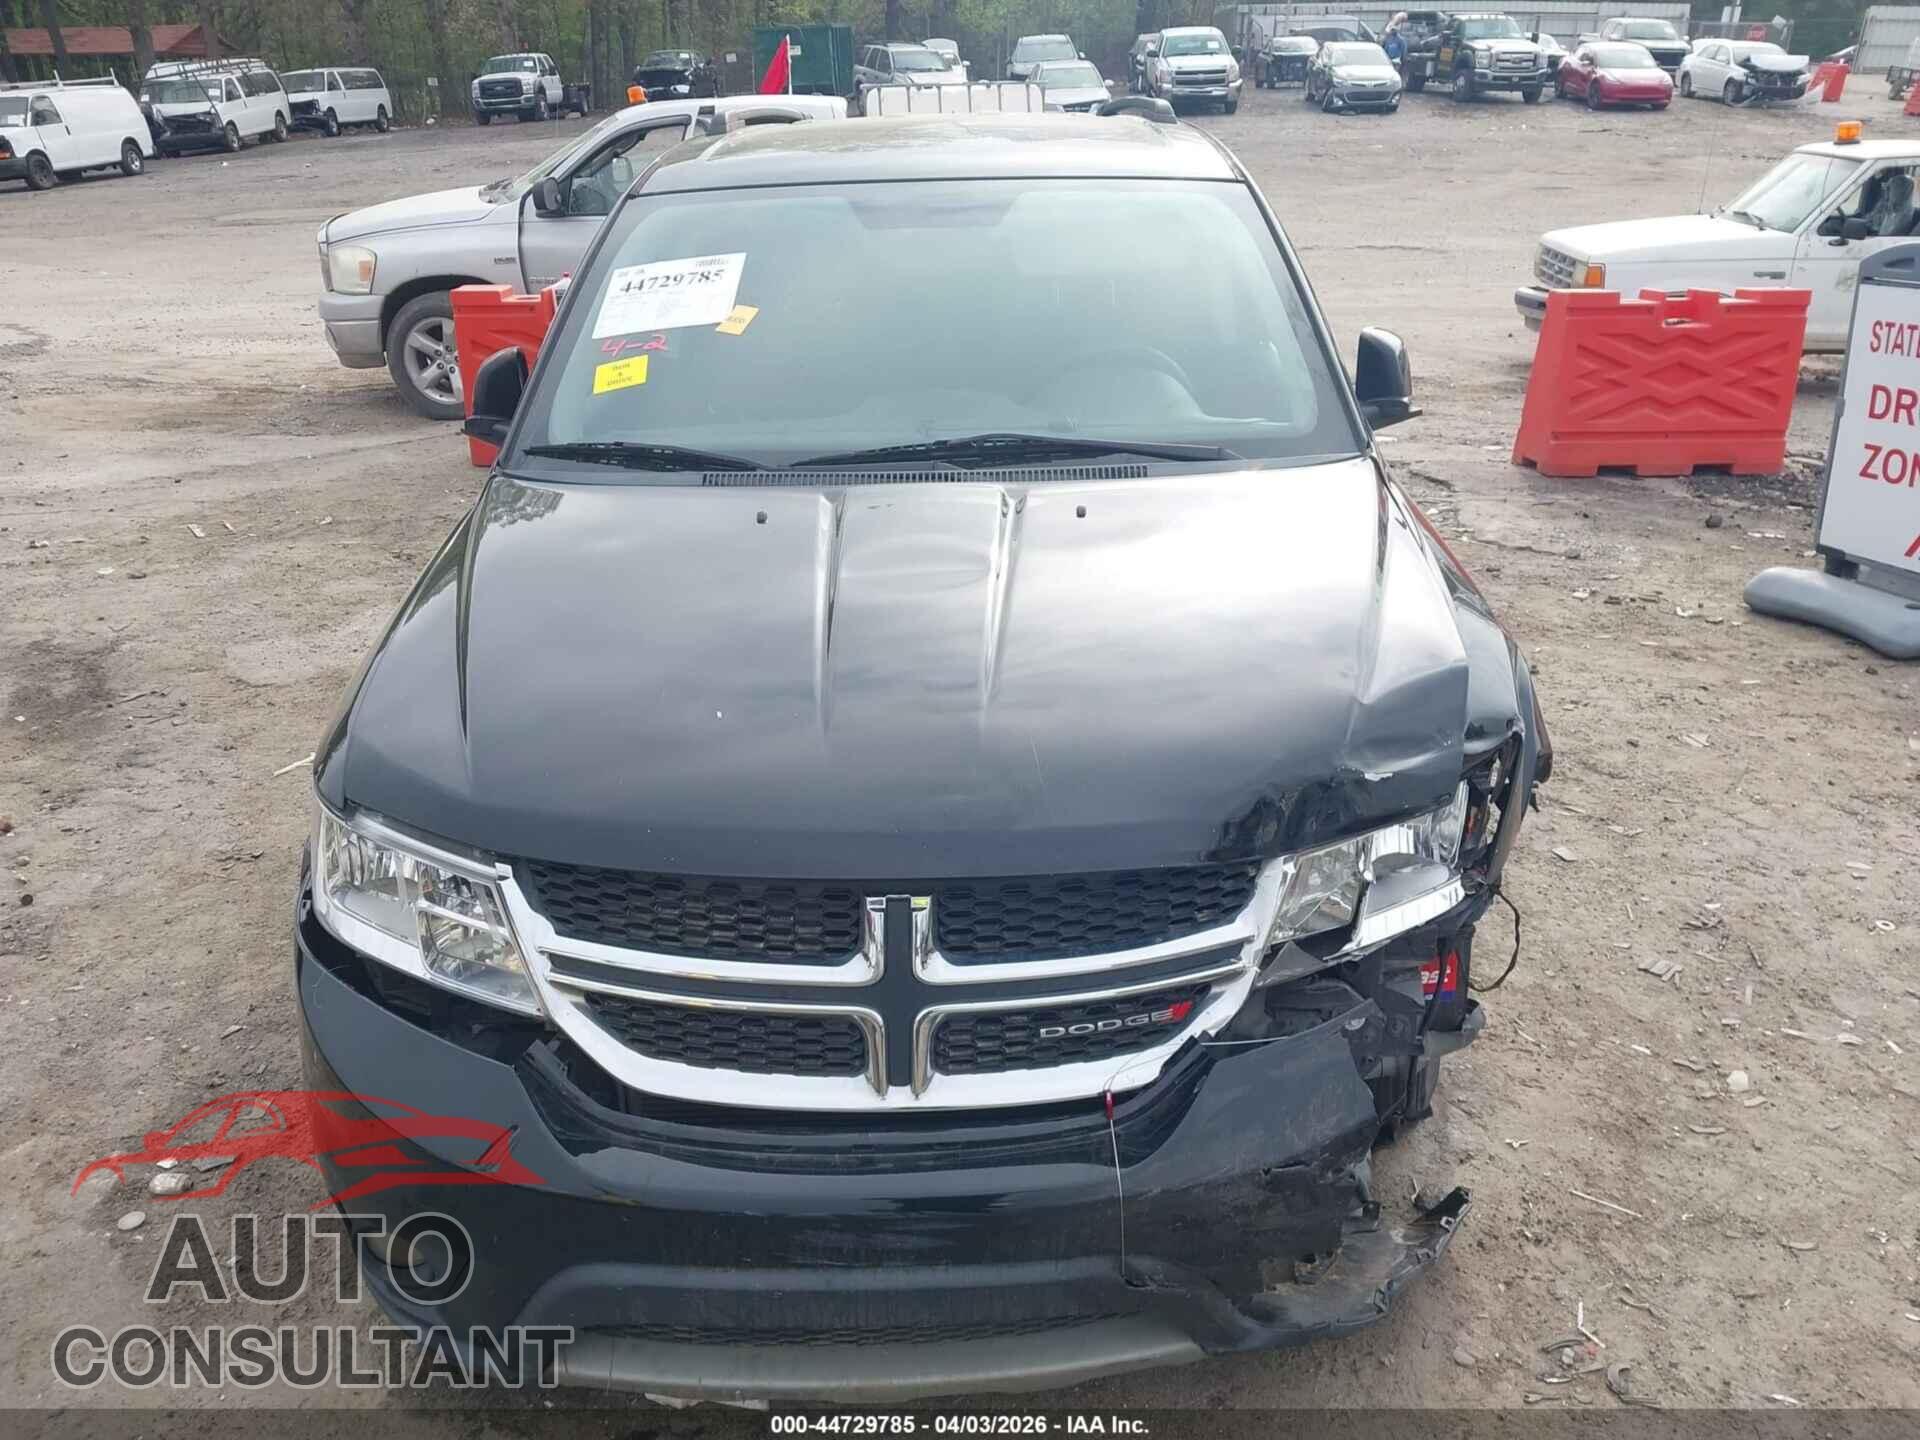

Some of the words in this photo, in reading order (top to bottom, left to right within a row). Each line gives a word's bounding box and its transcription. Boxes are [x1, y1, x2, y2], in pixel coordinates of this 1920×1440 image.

[619, 269, 724, 293] 44729785
[1868, 384, 1920, 426] DR
[1039, 1008, 1174, 1038] DODGE
